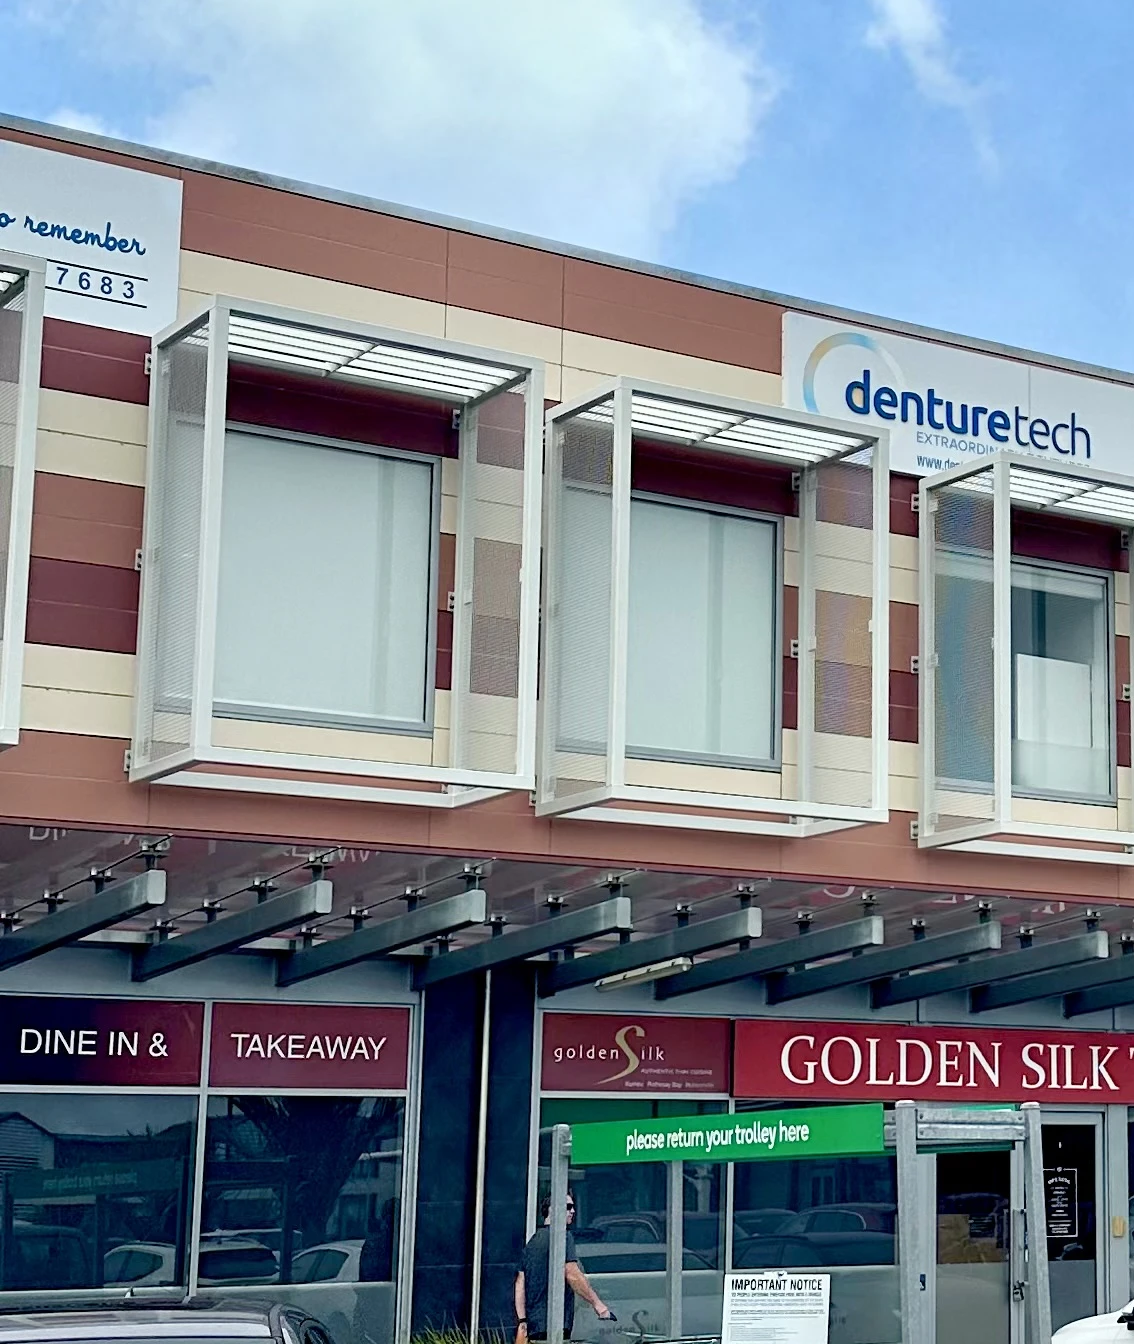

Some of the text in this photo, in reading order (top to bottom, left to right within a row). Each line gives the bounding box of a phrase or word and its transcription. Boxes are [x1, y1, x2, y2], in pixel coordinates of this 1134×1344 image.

[24, 215, 146, 256] remember
[845, 369, 1091, 459] denturetech
[916, 431, 1024, 456] EXTRAORDI
[19, 1028, 169, 1058] DINE IN &
[230, 1032, 388, 1061] TAKEAWAY
[780, 1035, 1003, 1088] GOLDEN
[1021, 1042, 1120, 1090] SILK
[626, 1119, 810, 1156] please return your trolley here
[731, 1278, 823, 1291] IMPORTANT NOTICE
